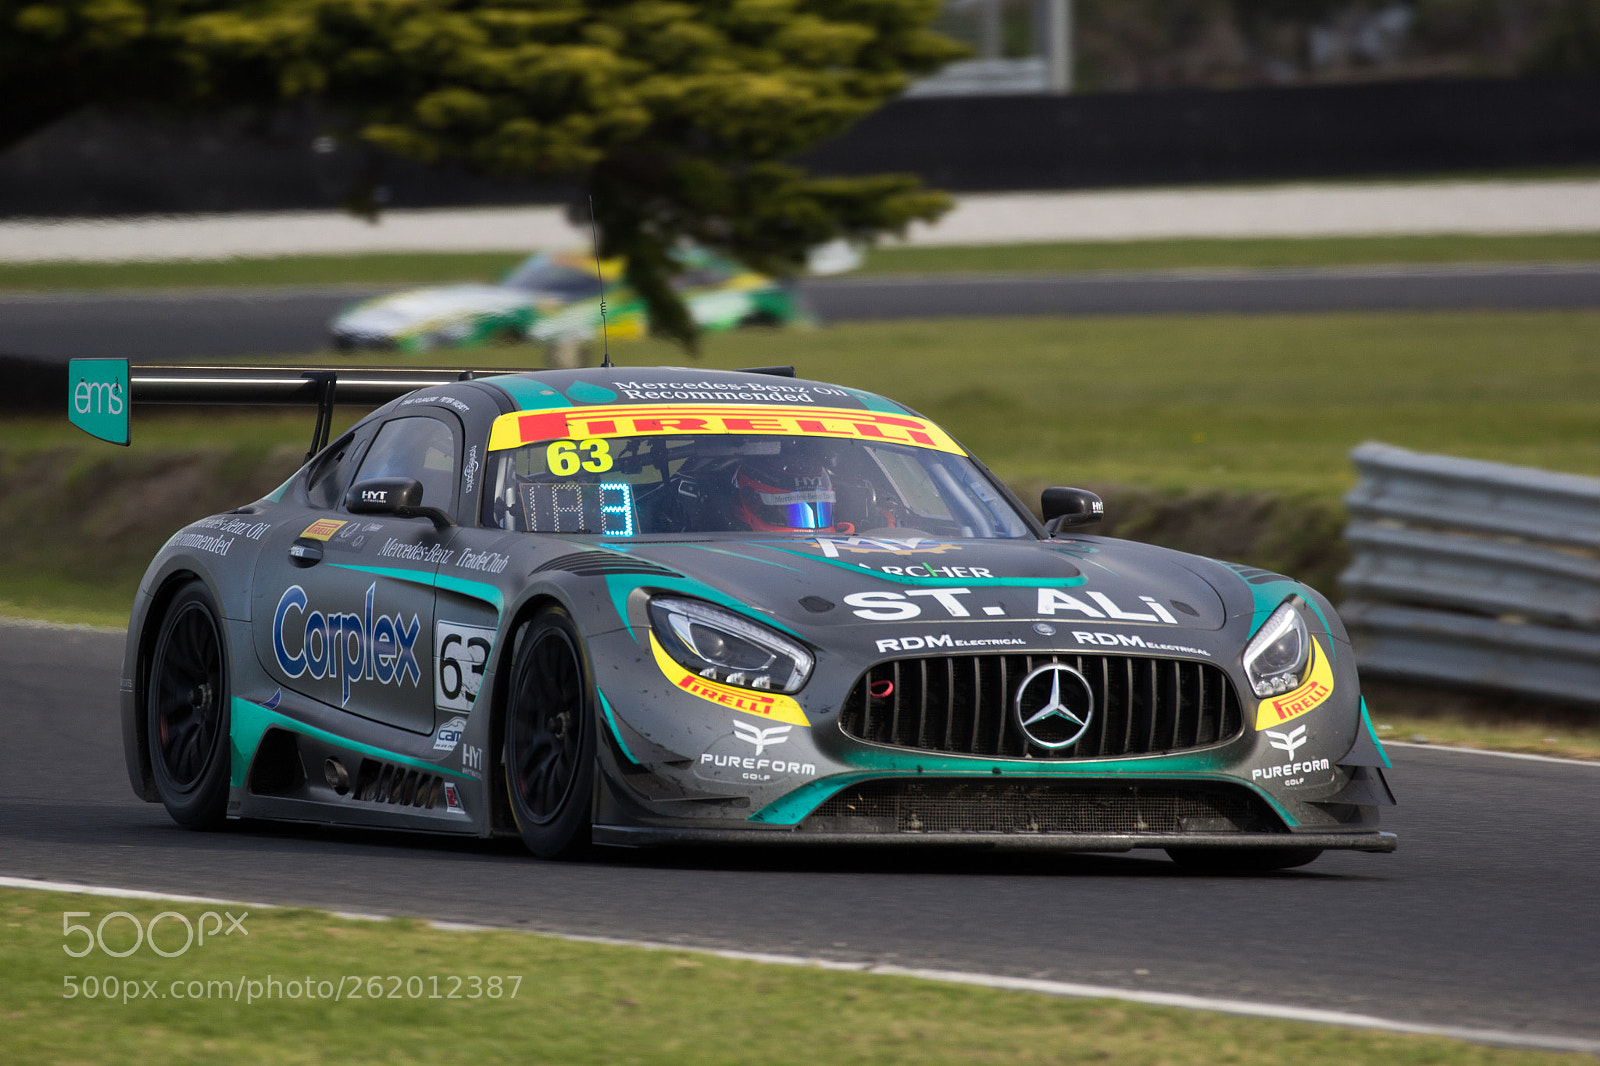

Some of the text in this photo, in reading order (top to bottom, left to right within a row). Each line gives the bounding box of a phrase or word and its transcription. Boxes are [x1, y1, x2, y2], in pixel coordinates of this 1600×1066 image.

[74, 380, 123, 415] ems
[612, 381, 809, 393] Mercedes-Benz
[621, 389, 815, 403] Recommended
[517, 406, 938, 447] PIRELLI
[546, 438, 613, 476] 63
[361, 490, 388, 500] HYT
[246, 522, 271, 540] Oil
[306, 521, 341, 536] PIRELLI
[377, 537, 510, 574] Mercedes-Benz TradeClub
[858, 562, 994, 578] RCHER
[843, 587, 1178, 624] ST. ALi
[272, 580, 422, 709] Corplex
[875, 634, 1026, 653] RDM ELECTRICAL
[1071, 631, 1211, 657] RDM ELECTRICAL
[439, 633, 492, 703] 63
[678, 674, 775, 715] PIRELLI
[1271, 681, 1329, 720] PIRELLI
[462, 743, 483, 771] HYT
[700, 753, 816, 776] PUREFORM
[742, 772, 771, 781] GOLF
[1251, 758, 1330, 781] PUREFORM
[1284, 777, 1305, 787] GOLF
